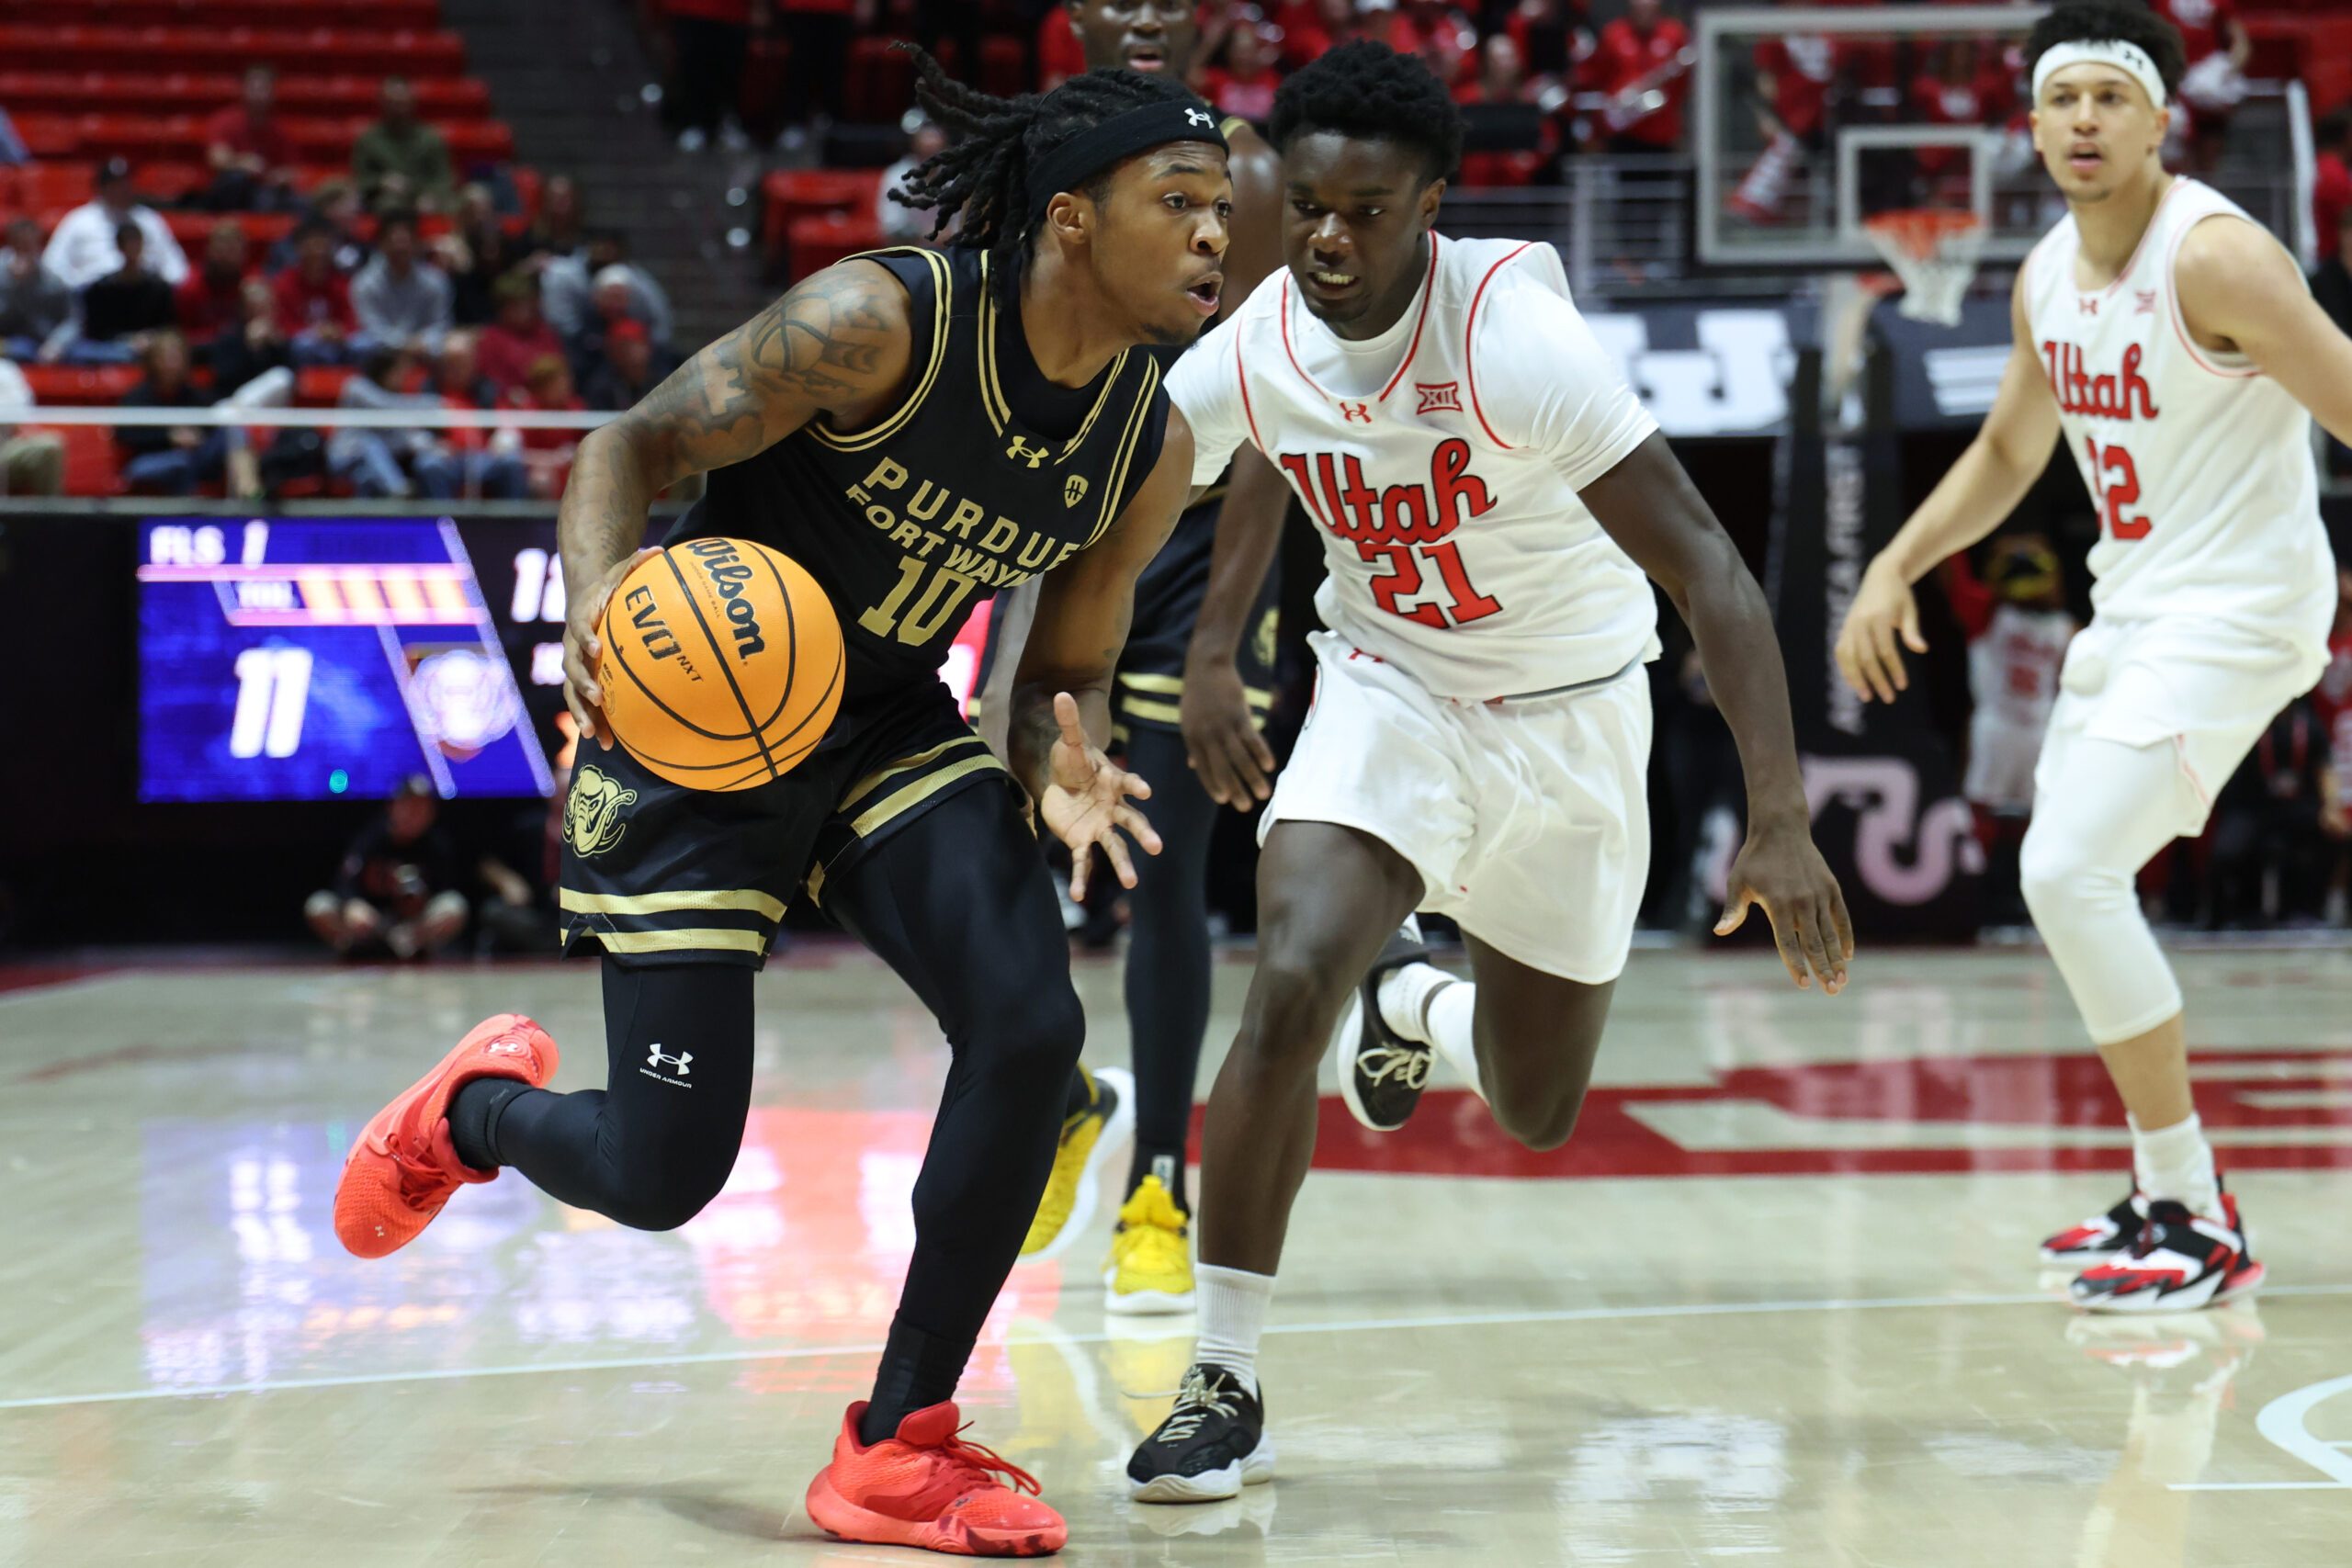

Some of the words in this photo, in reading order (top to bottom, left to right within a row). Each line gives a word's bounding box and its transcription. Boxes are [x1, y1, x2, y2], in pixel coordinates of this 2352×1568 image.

[2043, 340, 2159, 421] Utah
[845, 483, 945, 558] FORT
[943, 544, 1038, 588] WAYN
[863, 456, 1081, 572] PURDUE
[1280, 437, 1498, 546] Utah
[625, 584, 682, 660] EVO
[676, 655, 705, 683] NXT
[685, 538, 764, 660] Wilson
[857, 555, 978, 647] 10
[1355, 540, 1503, 630] 21
[230, 647, 314, 759] 11
[639, 1067, 661, 1079] UNDER
[662, 1077, 692, 1089] ARMOUR
